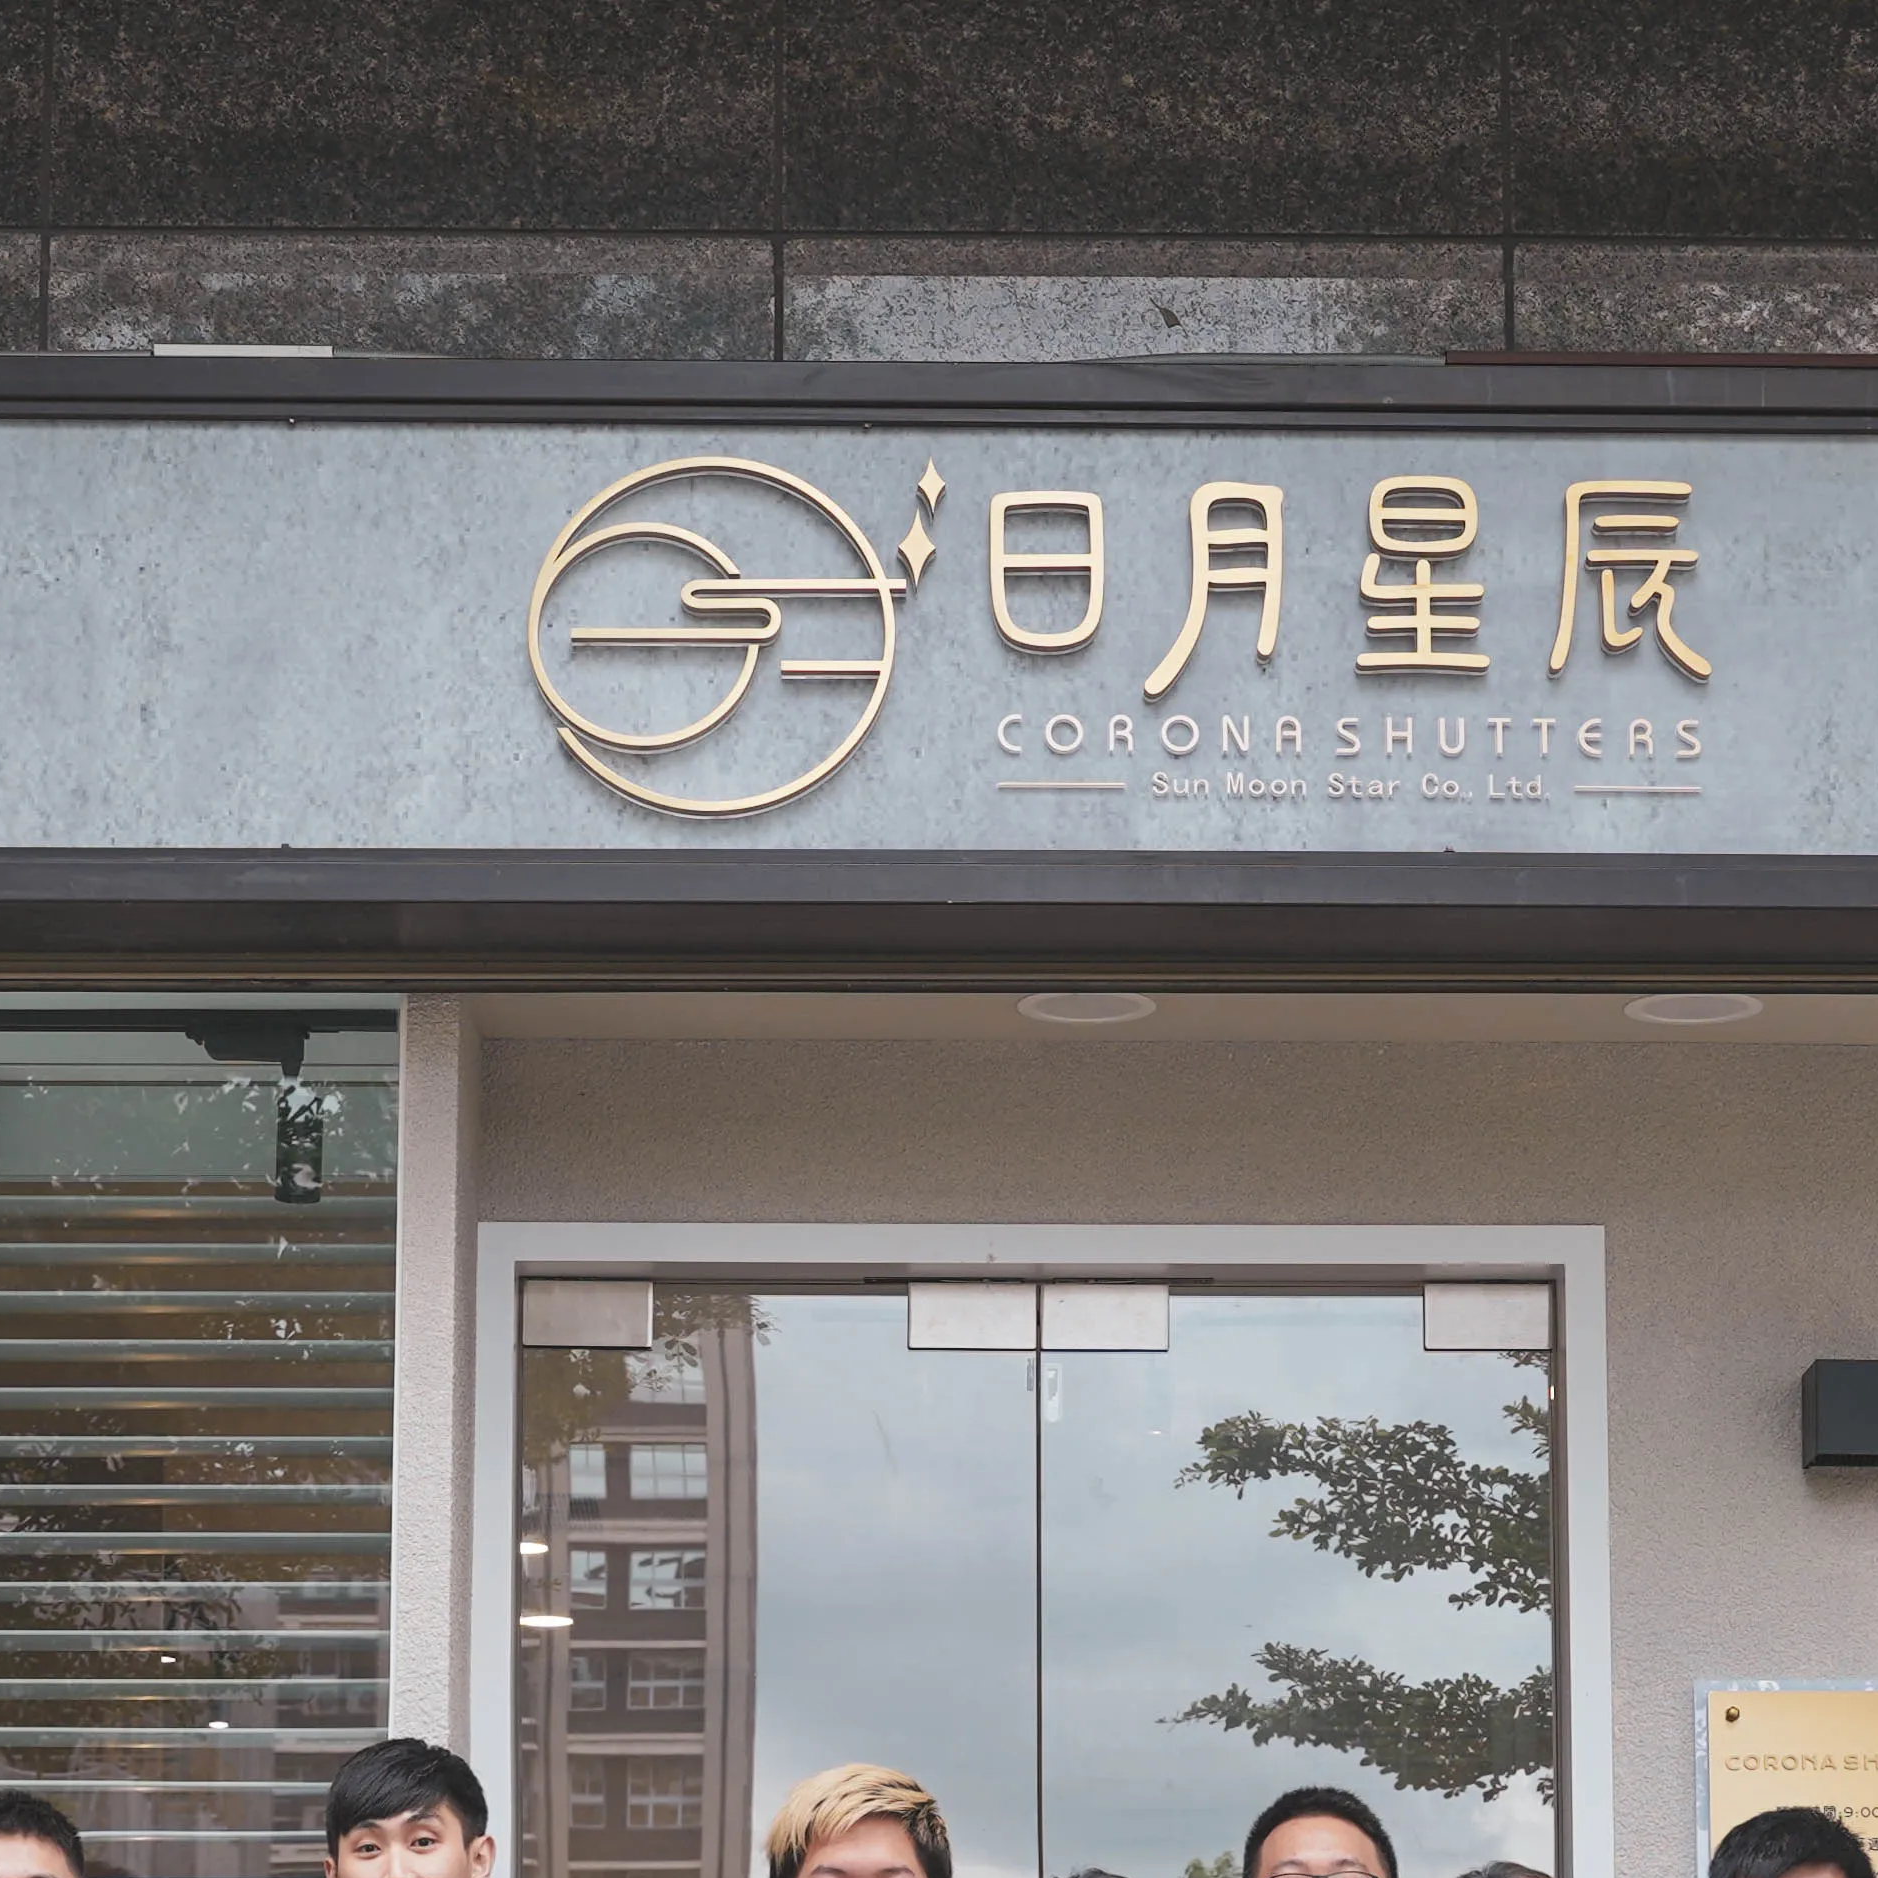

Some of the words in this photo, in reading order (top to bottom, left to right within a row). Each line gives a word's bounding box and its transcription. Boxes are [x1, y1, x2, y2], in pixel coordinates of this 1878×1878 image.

[990, 475, 1712, 703] 日月星辰
[996, 714, 1303, 757] CORONA
[1334, 716, 1702, 758] SHUTTERS
[1151, 771, 1210, 800] Sun
[1226, 771, 1307, 800] Moon
[1327, 772, 1400, 800] Star
[1724, 1753, 1838, 1772] CORONA
